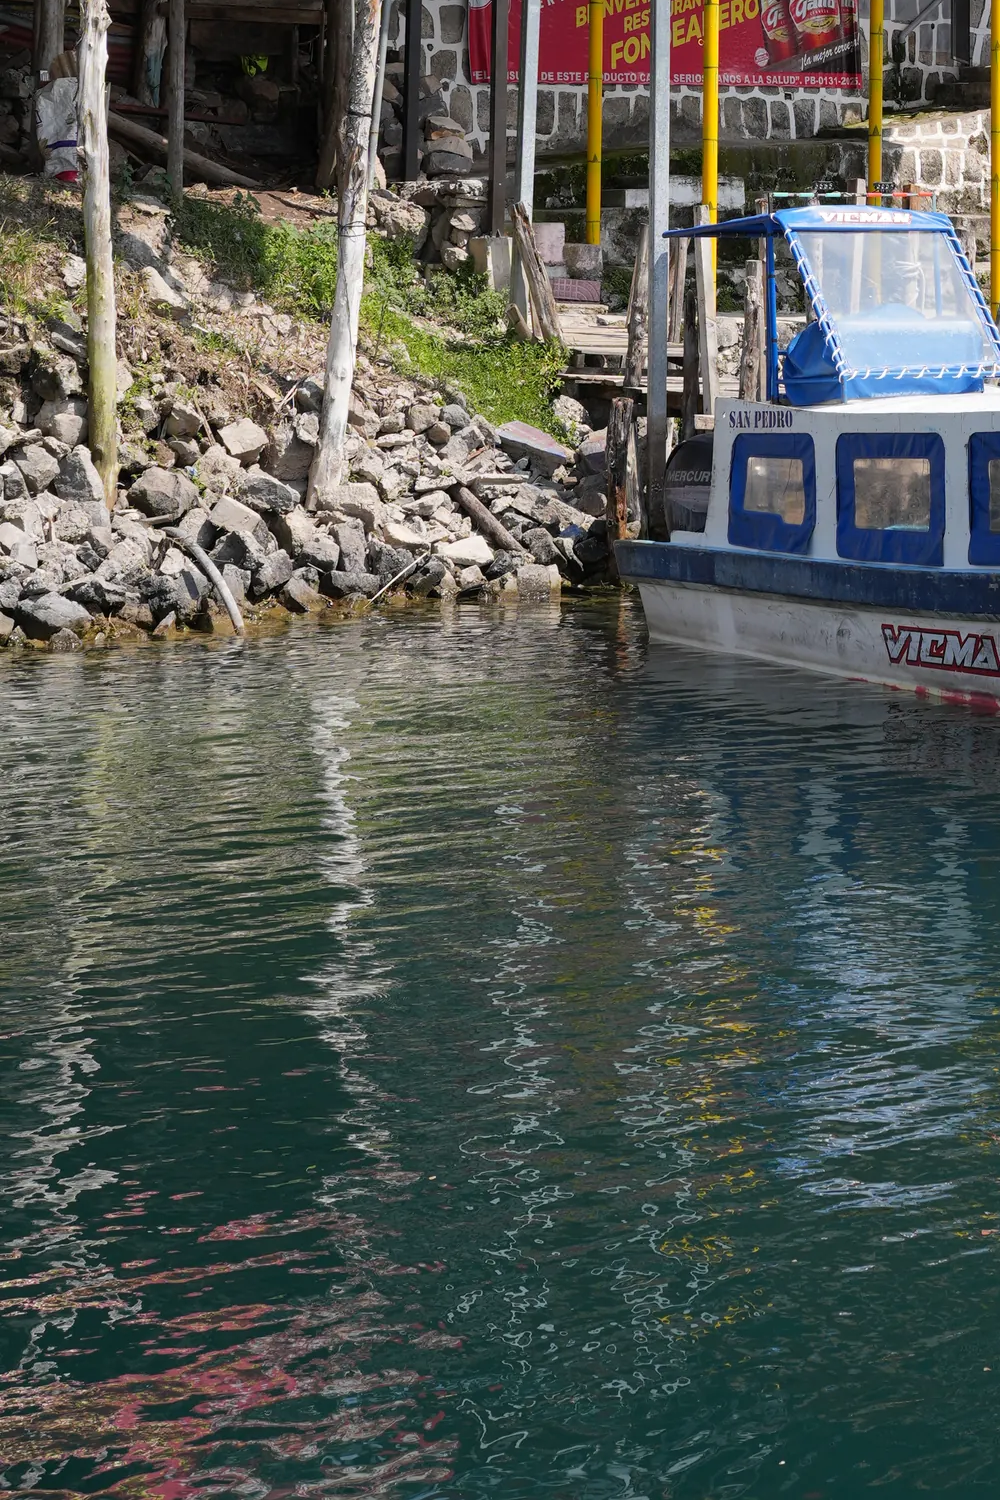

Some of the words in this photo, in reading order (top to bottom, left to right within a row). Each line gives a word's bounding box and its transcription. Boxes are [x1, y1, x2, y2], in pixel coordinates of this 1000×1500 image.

[813, 49, 833, 63] mejor
[541, 71, 554, 81] DE
[556, 71, 582, 81] ESTE
[584, 71, 637, 82] PDUCTO
[717, 72, 742, 84] AÑOS
[744, 74, 751, 84] A
[752, 74, 764, 84] LA
[819, 211, 912, 225] VICMAN
[729, 410, 751, 429] SAN
[754, 410, 793, 429] PEDRO
[667, 470, 713, 483] MERCUR
